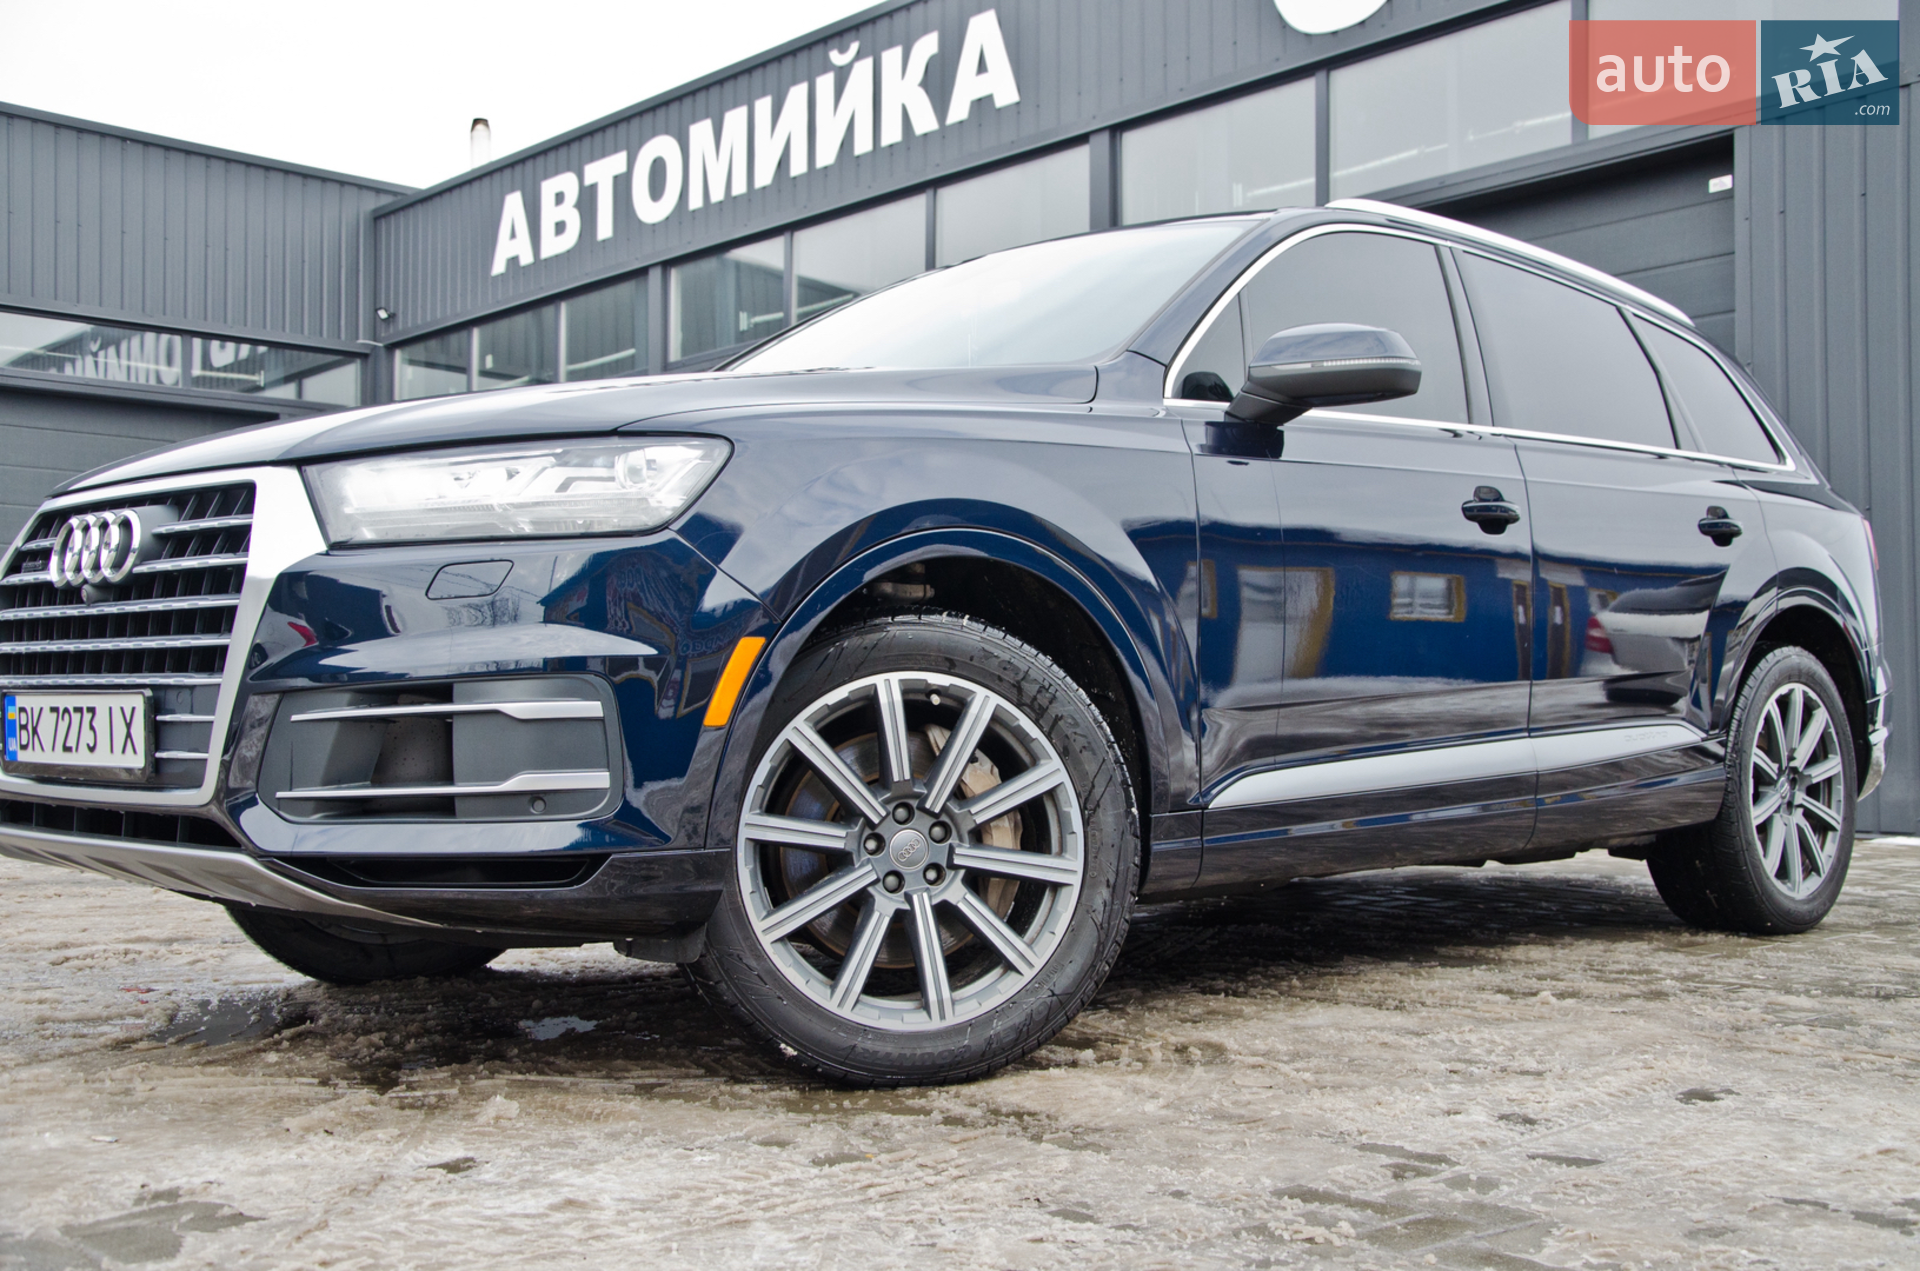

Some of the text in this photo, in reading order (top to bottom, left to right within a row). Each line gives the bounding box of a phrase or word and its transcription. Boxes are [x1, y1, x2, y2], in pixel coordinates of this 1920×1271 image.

[491, 8, 1021, 277] АВТОМИЙКА
[8, 737, 17, 751] UA
[18, 706, 138, 755] BK 7273 IX
